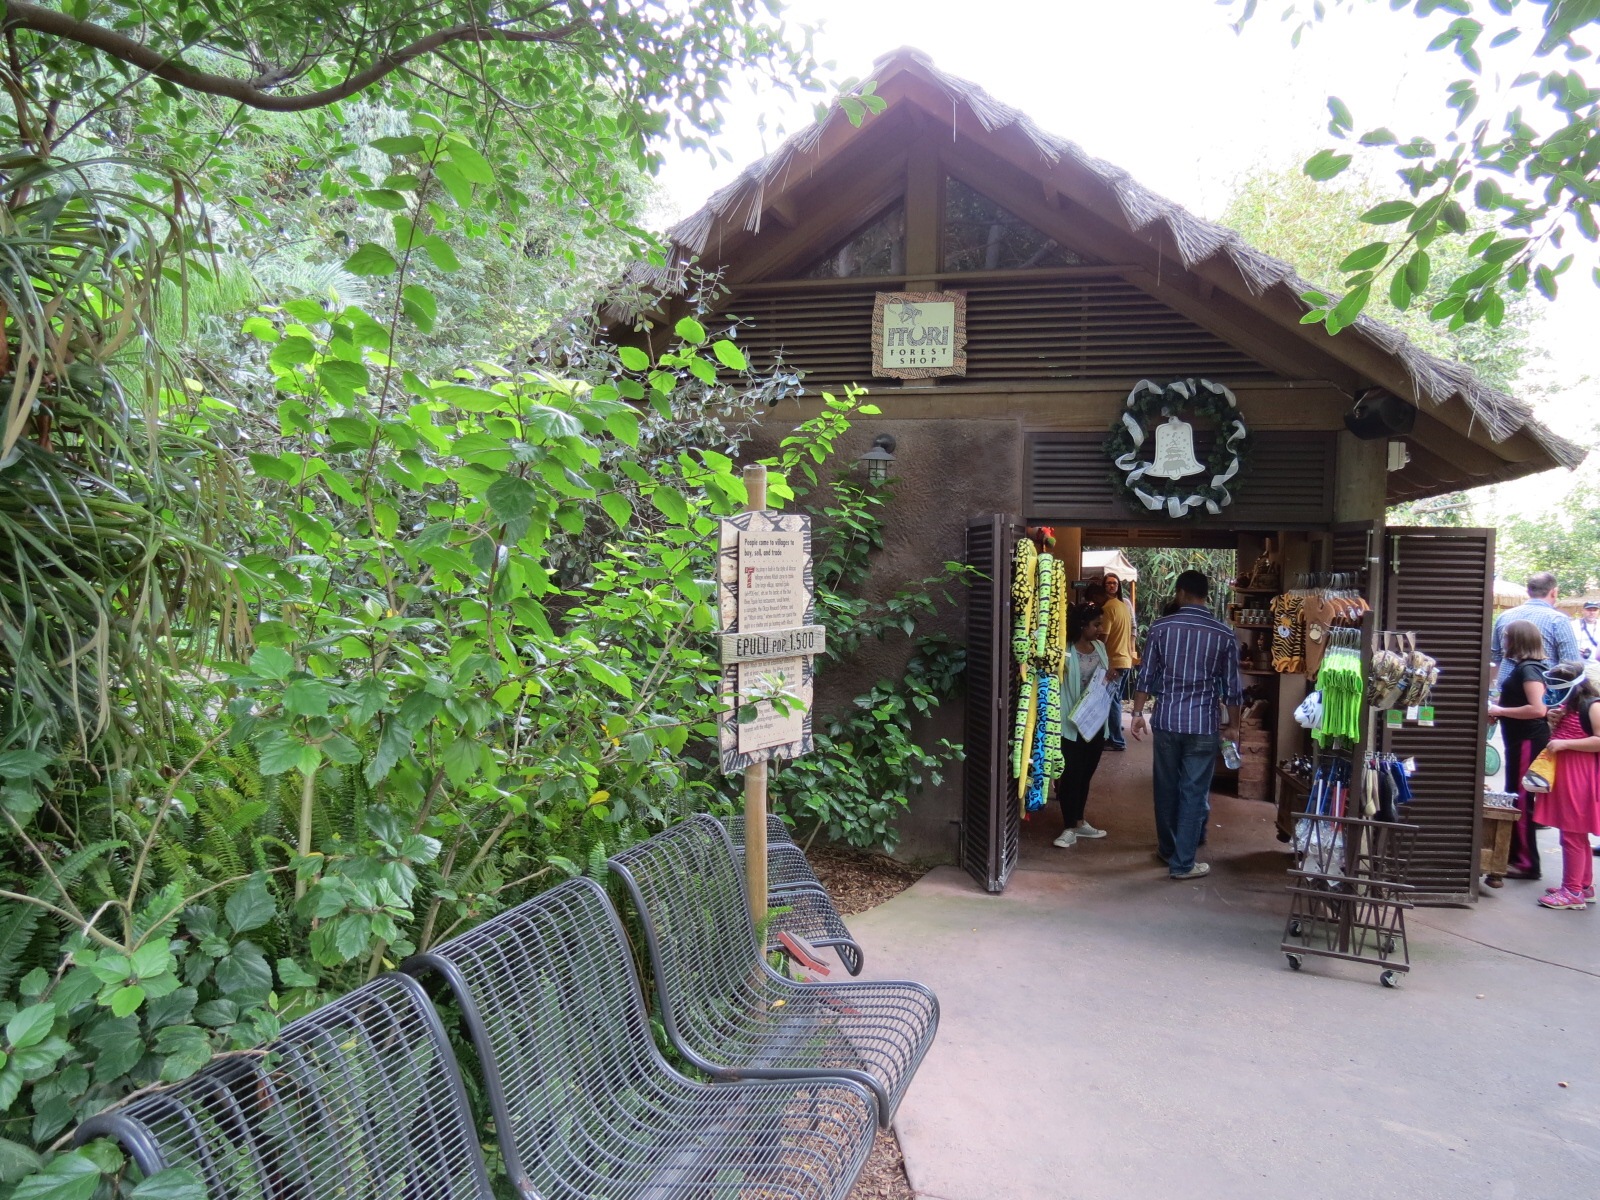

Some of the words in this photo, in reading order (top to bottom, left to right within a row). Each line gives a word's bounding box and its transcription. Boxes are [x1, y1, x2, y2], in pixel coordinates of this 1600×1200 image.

[891, 348, 946, 356] FOREST
[744, 538, 758, 548] People
[775, 538, 790, 547] villages
[736, 637, 769, 656] EPULU
